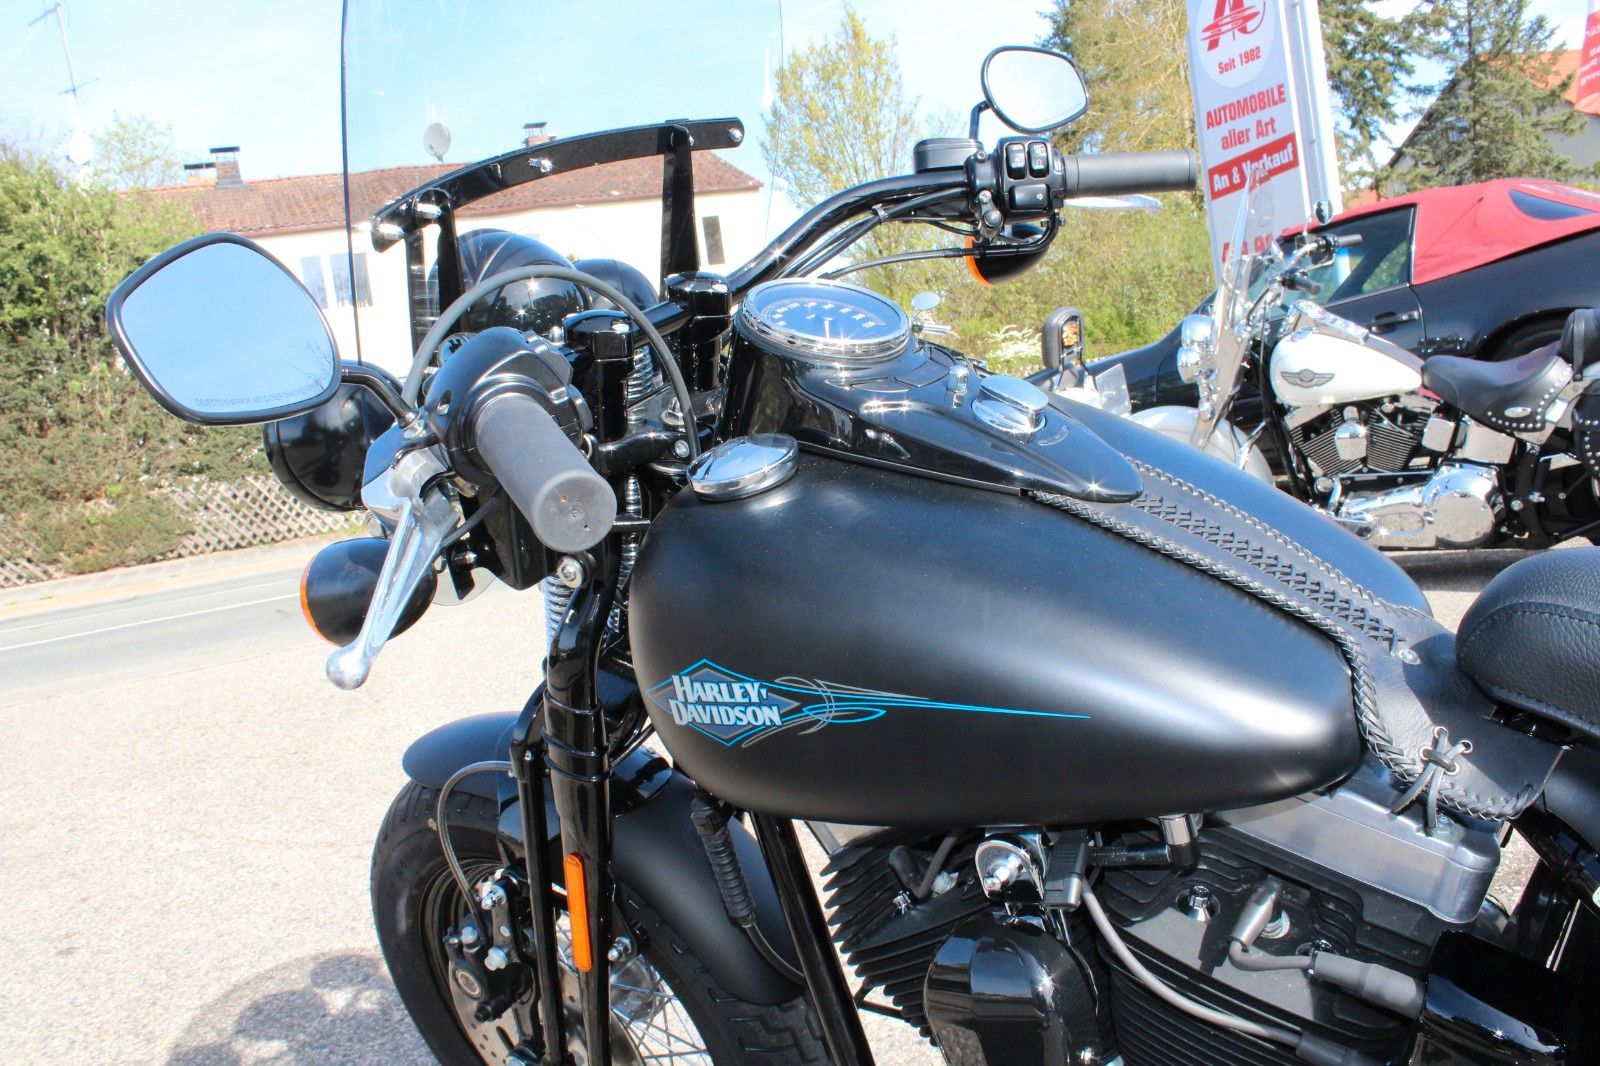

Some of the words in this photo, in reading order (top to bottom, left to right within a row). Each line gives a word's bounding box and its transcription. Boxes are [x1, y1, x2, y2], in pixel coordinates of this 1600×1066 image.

[1218, 58, 1236, 74] Seit
[1239, 46, 1261, 66] 1982
[1206, 83, 1286, 129] AUTOMOBILE
[1221, 128, 1250, 150] aller
[1256, 116, 1276, 139] Art
[1213, 173, 1229, 192] An
[1232, 166, 1240, 184] &
[669, 699, 782, 726] DAVIDSON
